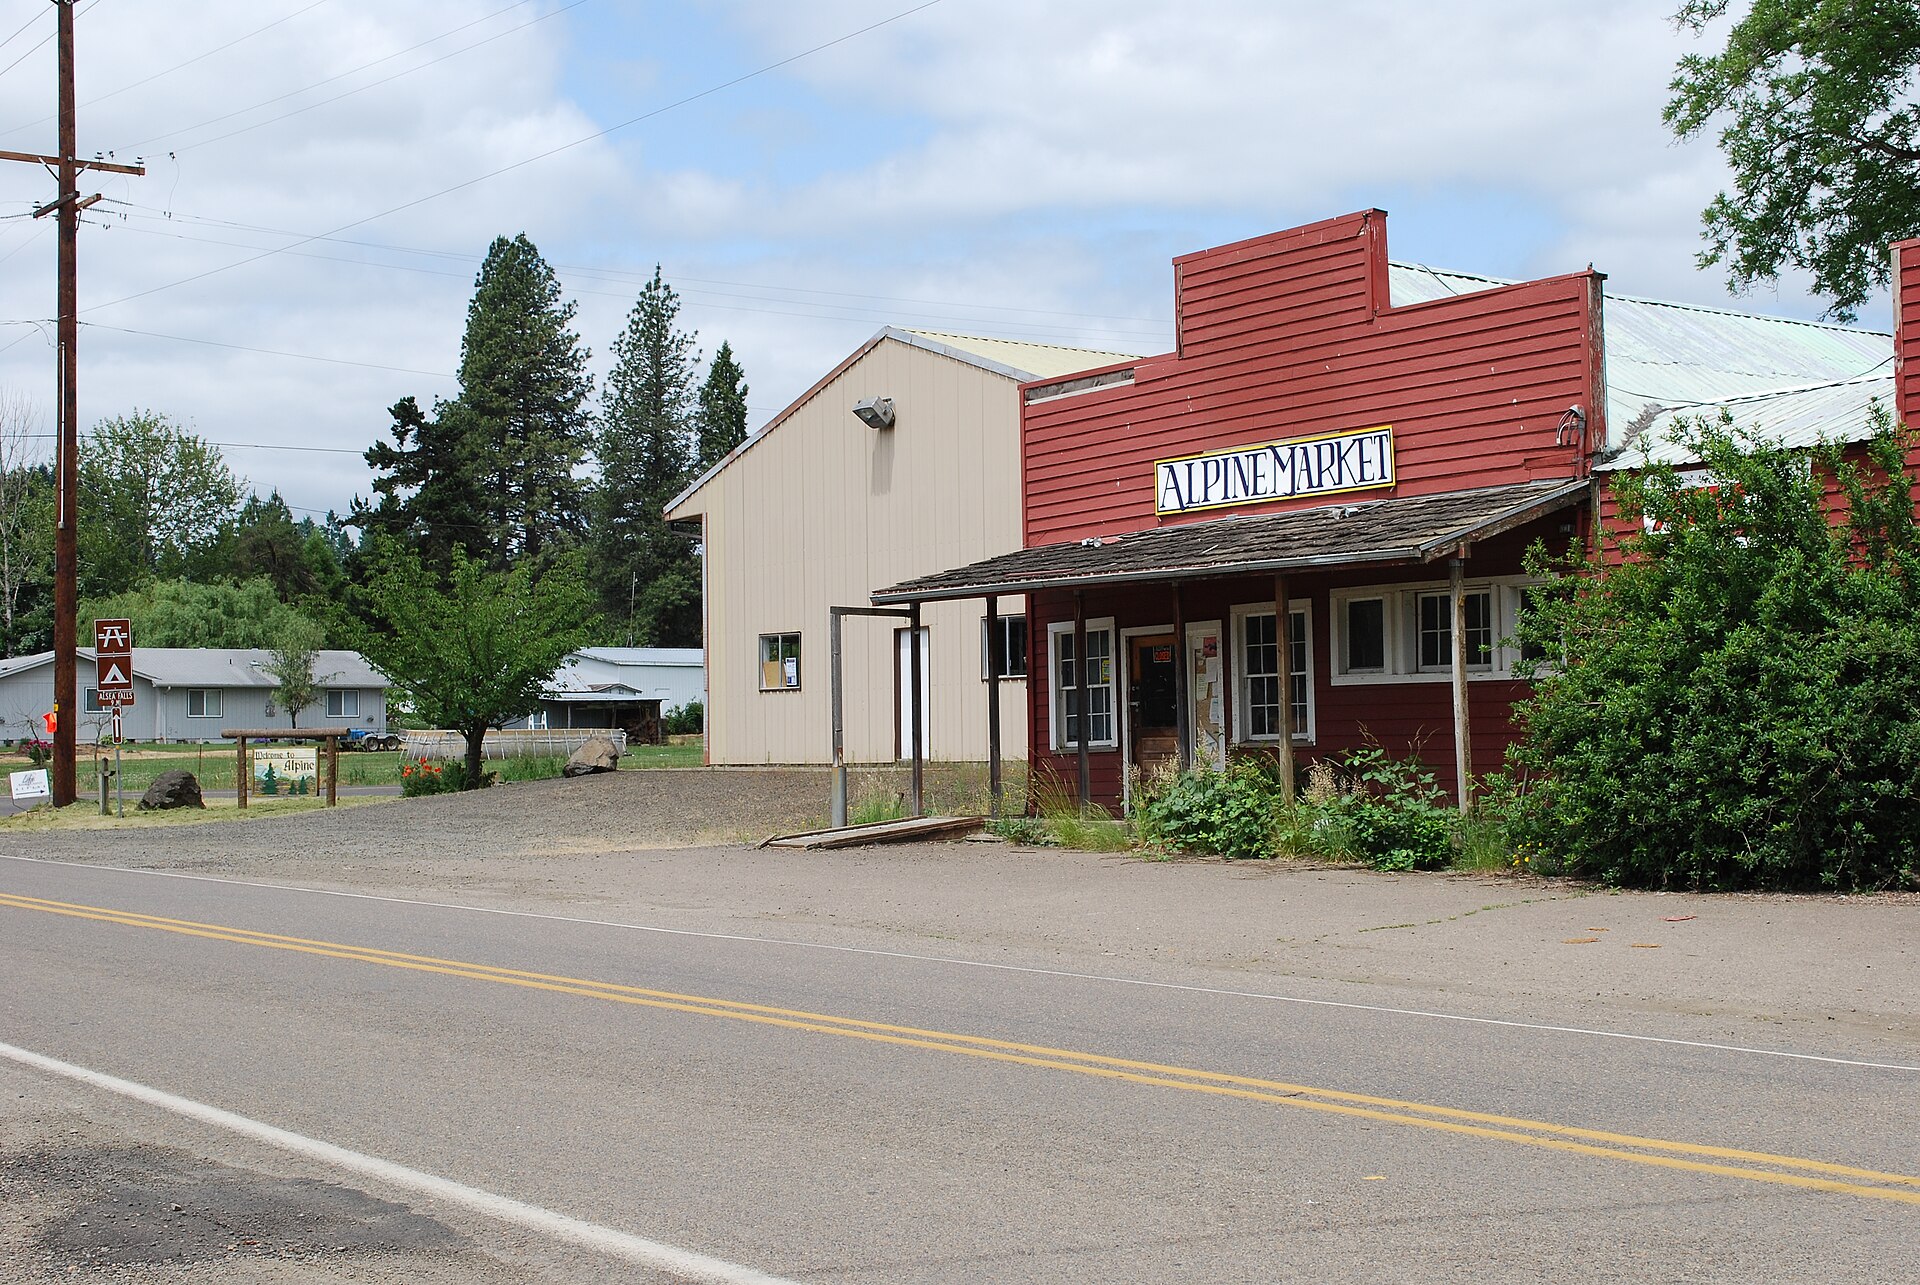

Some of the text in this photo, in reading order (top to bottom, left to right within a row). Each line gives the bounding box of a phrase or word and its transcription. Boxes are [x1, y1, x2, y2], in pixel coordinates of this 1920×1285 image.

[98, 692, 133, 700] ALSEA FALLS
[255, 752, 283, 760] Welcome
[284, 760, 314, 773] Alpine
